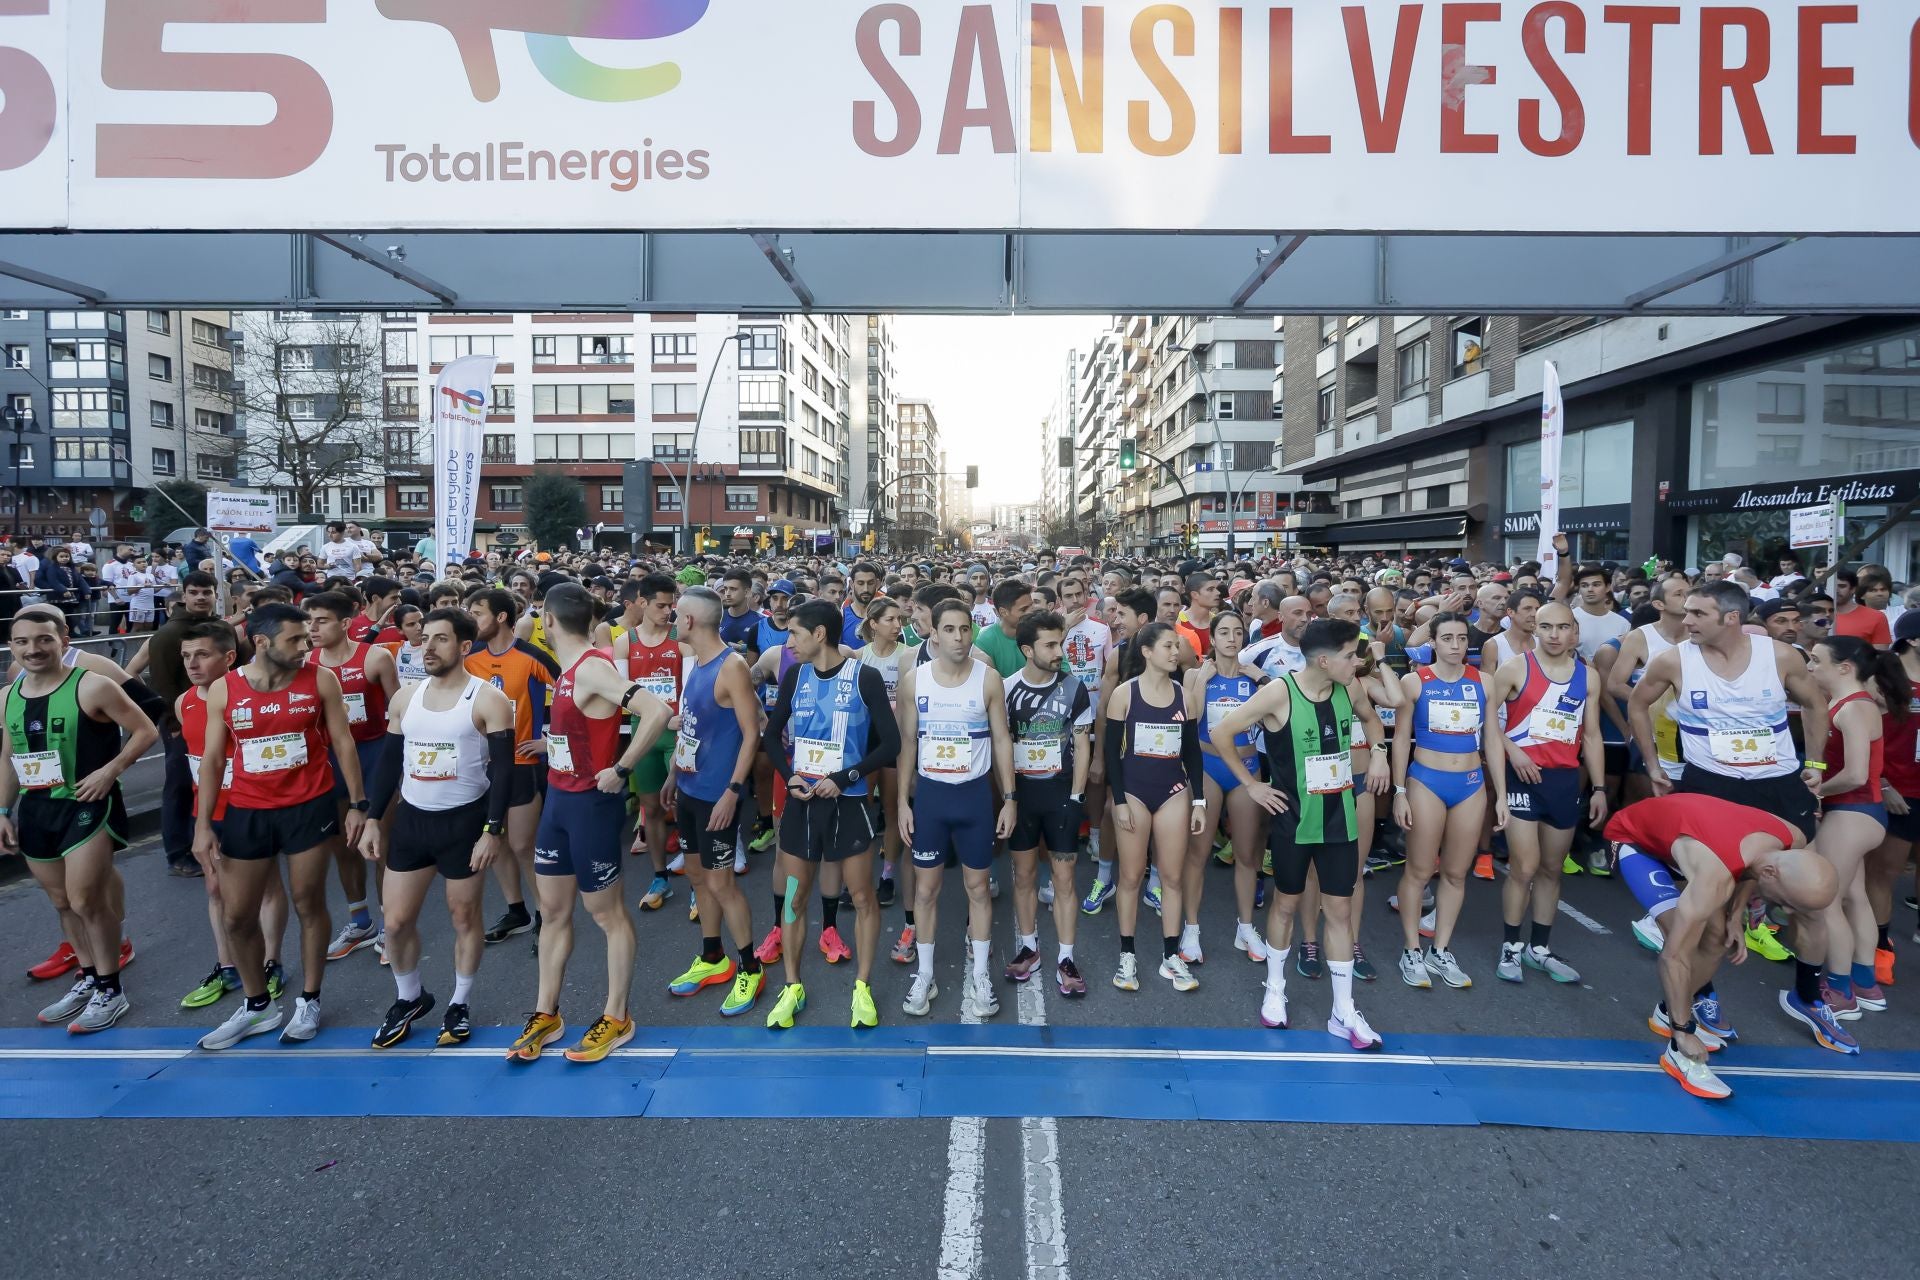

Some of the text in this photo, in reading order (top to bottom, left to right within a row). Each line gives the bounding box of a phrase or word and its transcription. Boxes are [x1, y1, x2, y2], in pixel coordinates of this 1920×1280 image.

[852, 2, 1860, 159] SANSILVESTRE
[374, 138, 710, 192] TotalEnergies
[1733, 486, 1812, 508] Alessandra
[0, 525, 86, 535] FRMACIA
[260, 702, 280, 714] edp
[1450, 709, 1461, 722] 3
[1546, 717, 1566, 731] 44
[1154, 733, 1164, 746] 2
[1731, 738, 1758, 753] 34
[261, 744, 288, 759] 45
[418, 751, 438, 766] 27
[808, 749, 825, 763] 17
[936, 745, 956, 759] 23
[1028, 749, 1047, 761] 39
[23, 762, 41, 776] 37
[1329, 764, 1338, 778] 1
